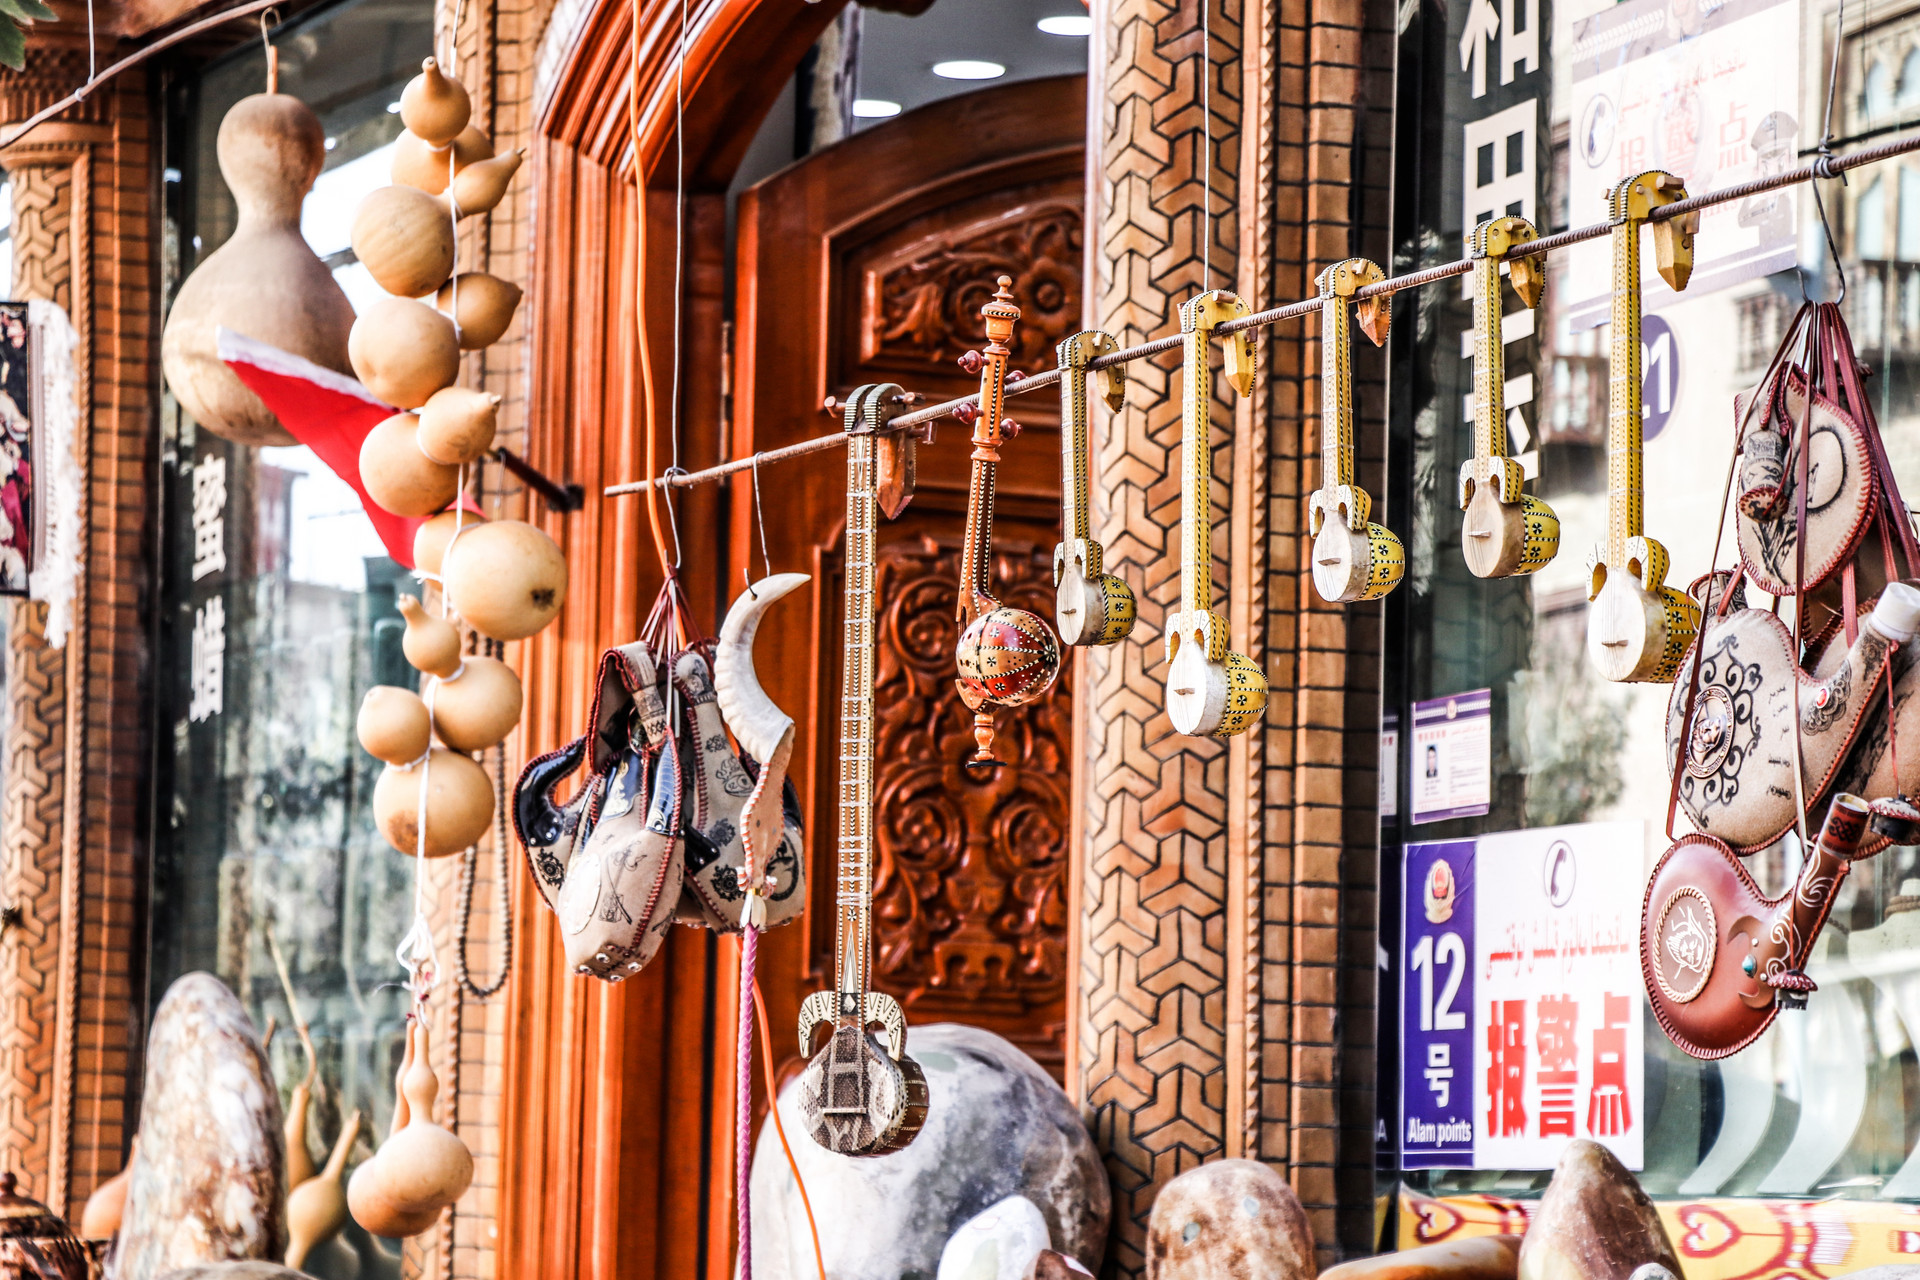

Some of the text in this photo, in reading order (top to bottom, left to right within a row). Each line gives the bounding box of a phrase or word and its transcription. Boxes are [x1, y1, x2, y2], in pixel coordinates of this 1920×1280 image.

[1411, 932, 1466, 1032] 12
[1424, 1042, 1453, 1108] 号
[1487, 992, 1633, 1138] 报警点
[1407, 1117, 1435, 1143] Alam
[1436, 1116, 1472, 1148] points
